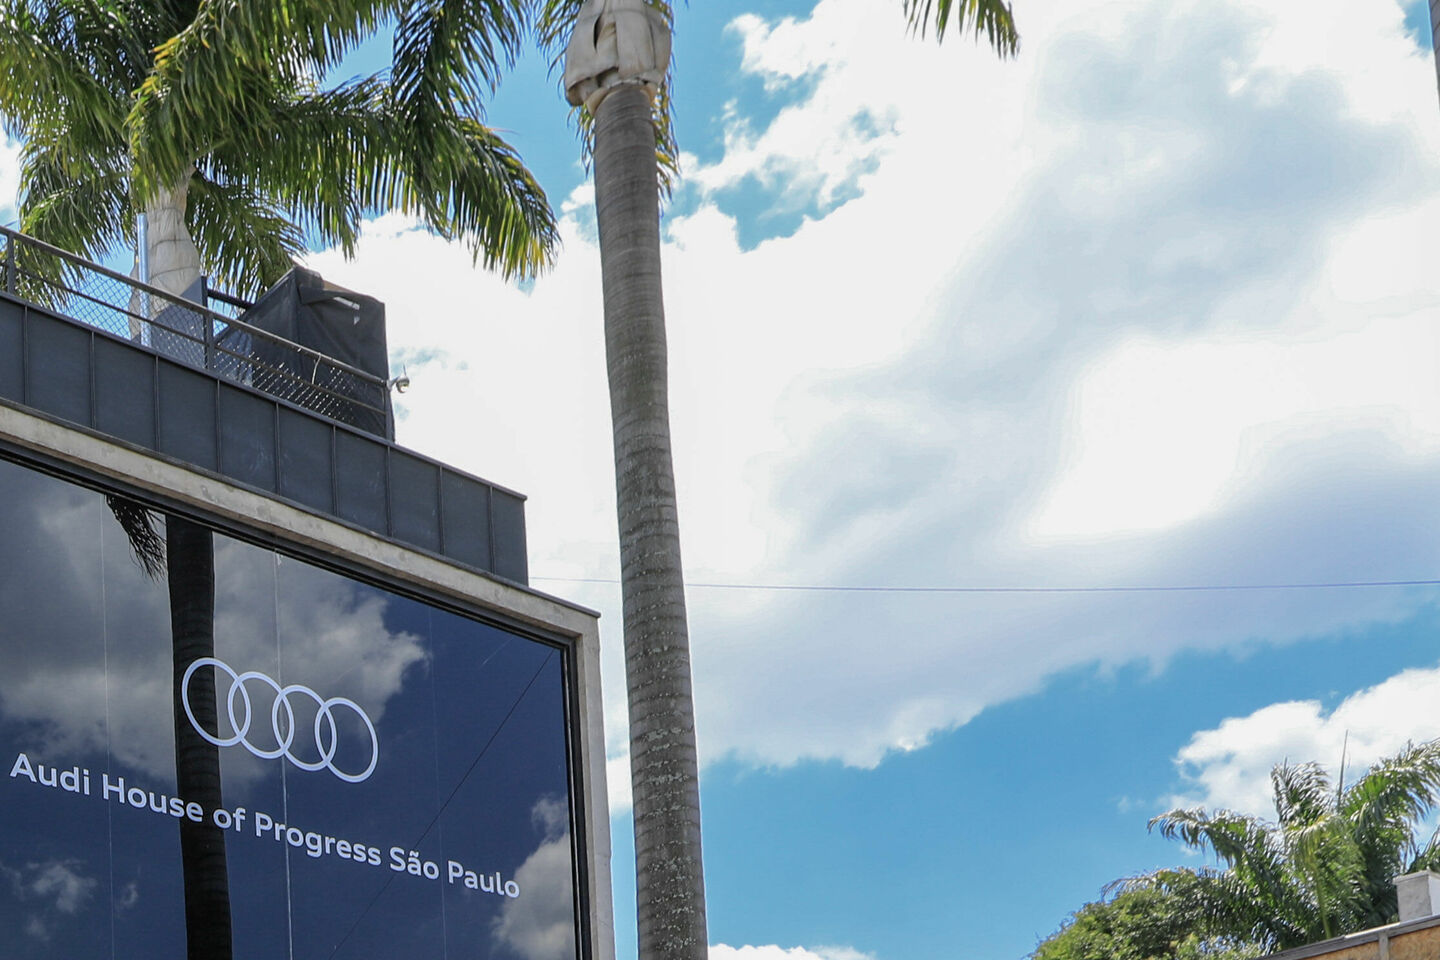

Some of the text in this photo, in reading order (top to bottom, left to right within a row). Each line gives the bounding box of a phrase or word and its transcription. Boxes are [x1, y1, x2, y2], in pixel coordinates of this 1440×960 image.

[10, 752, 521, 899] Audi House of Progress São Paulo
